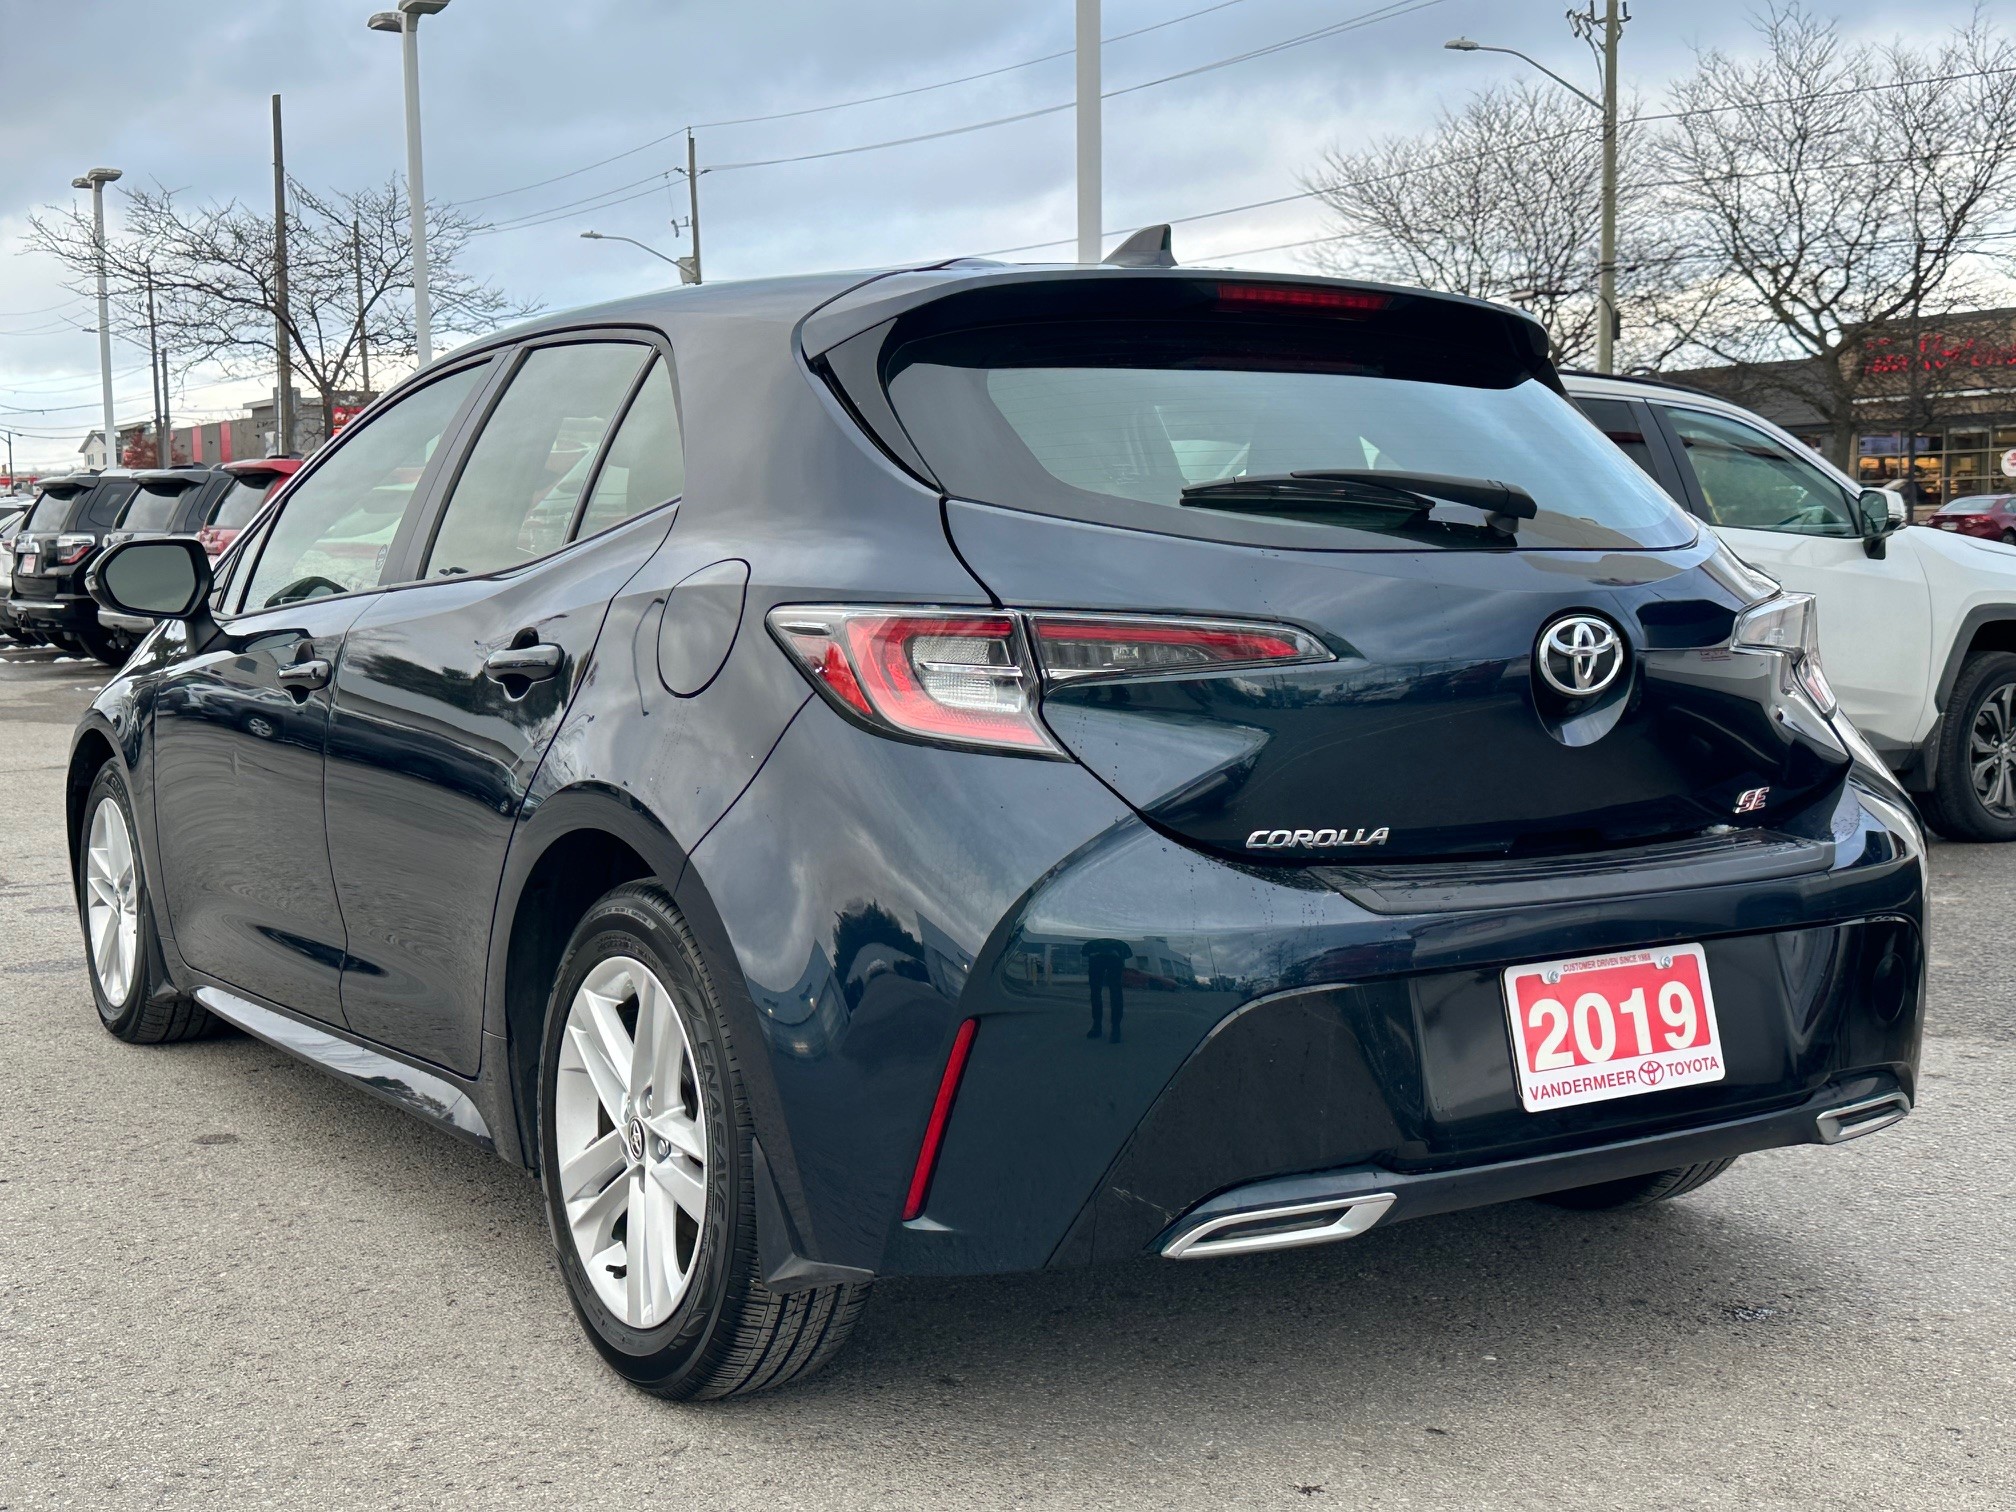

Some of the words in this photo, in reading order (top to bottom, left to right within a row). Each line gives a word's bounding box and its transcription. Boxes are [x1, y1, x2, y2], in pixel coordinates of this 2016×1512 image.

[1733, 787, 1770, 813] SE
[1245, 827, 1390, 850] COROLLA
[1563, 960, 1596, 972] CUSTOMER
[1597, 957, 1619, 968] DRIVEN
[1619, 954, 1637, 964] SINCE
[1528, 980, 1698, 1072] 2019
[1529, 1070, 1637, 1101] VANDERMEER
[1666, 1056, 1719, 1078] TOYOTA
[699, 1041, 727, 1222] ENASAVE
